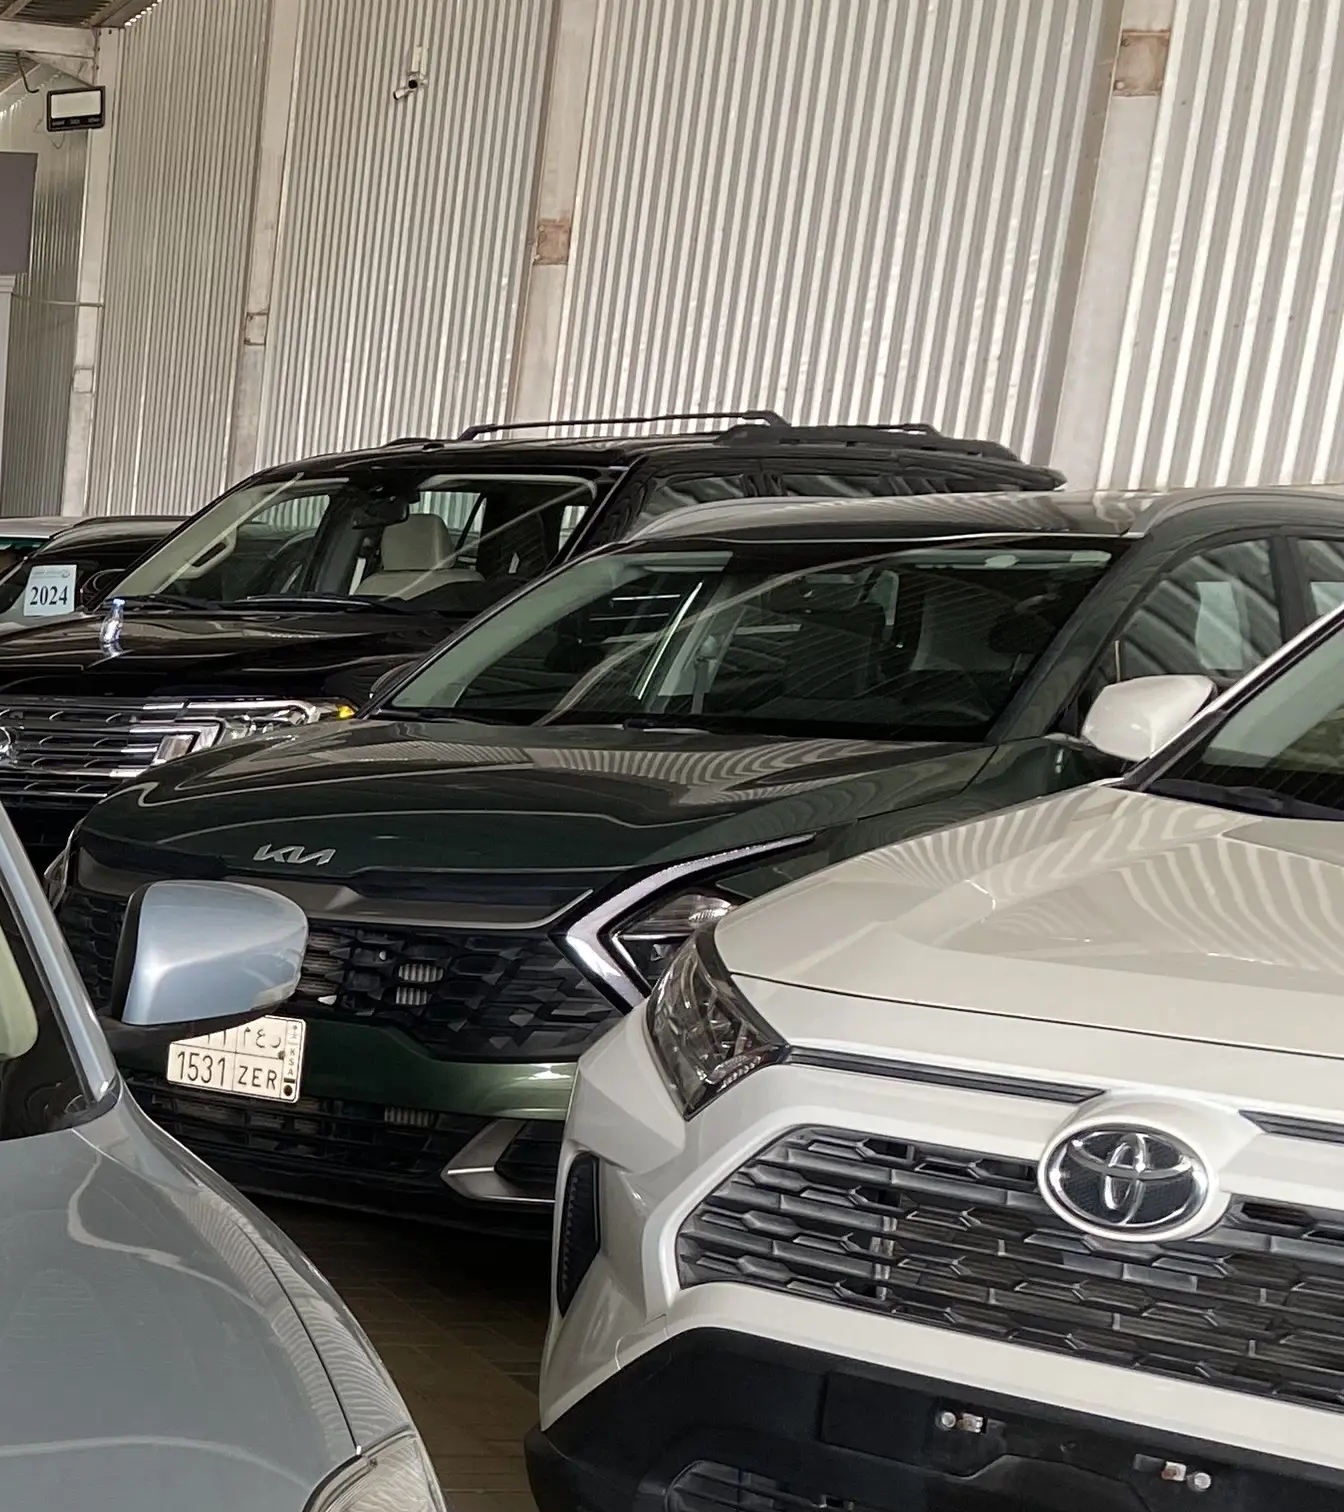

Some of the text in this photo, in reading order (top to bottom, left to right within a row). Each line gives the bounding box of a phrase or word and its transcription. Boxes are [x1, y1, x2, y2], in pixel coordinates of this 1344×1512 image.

[29, 585, 68, 606] 2024
[177, 1051, 278, 1090] 1531 ZER
